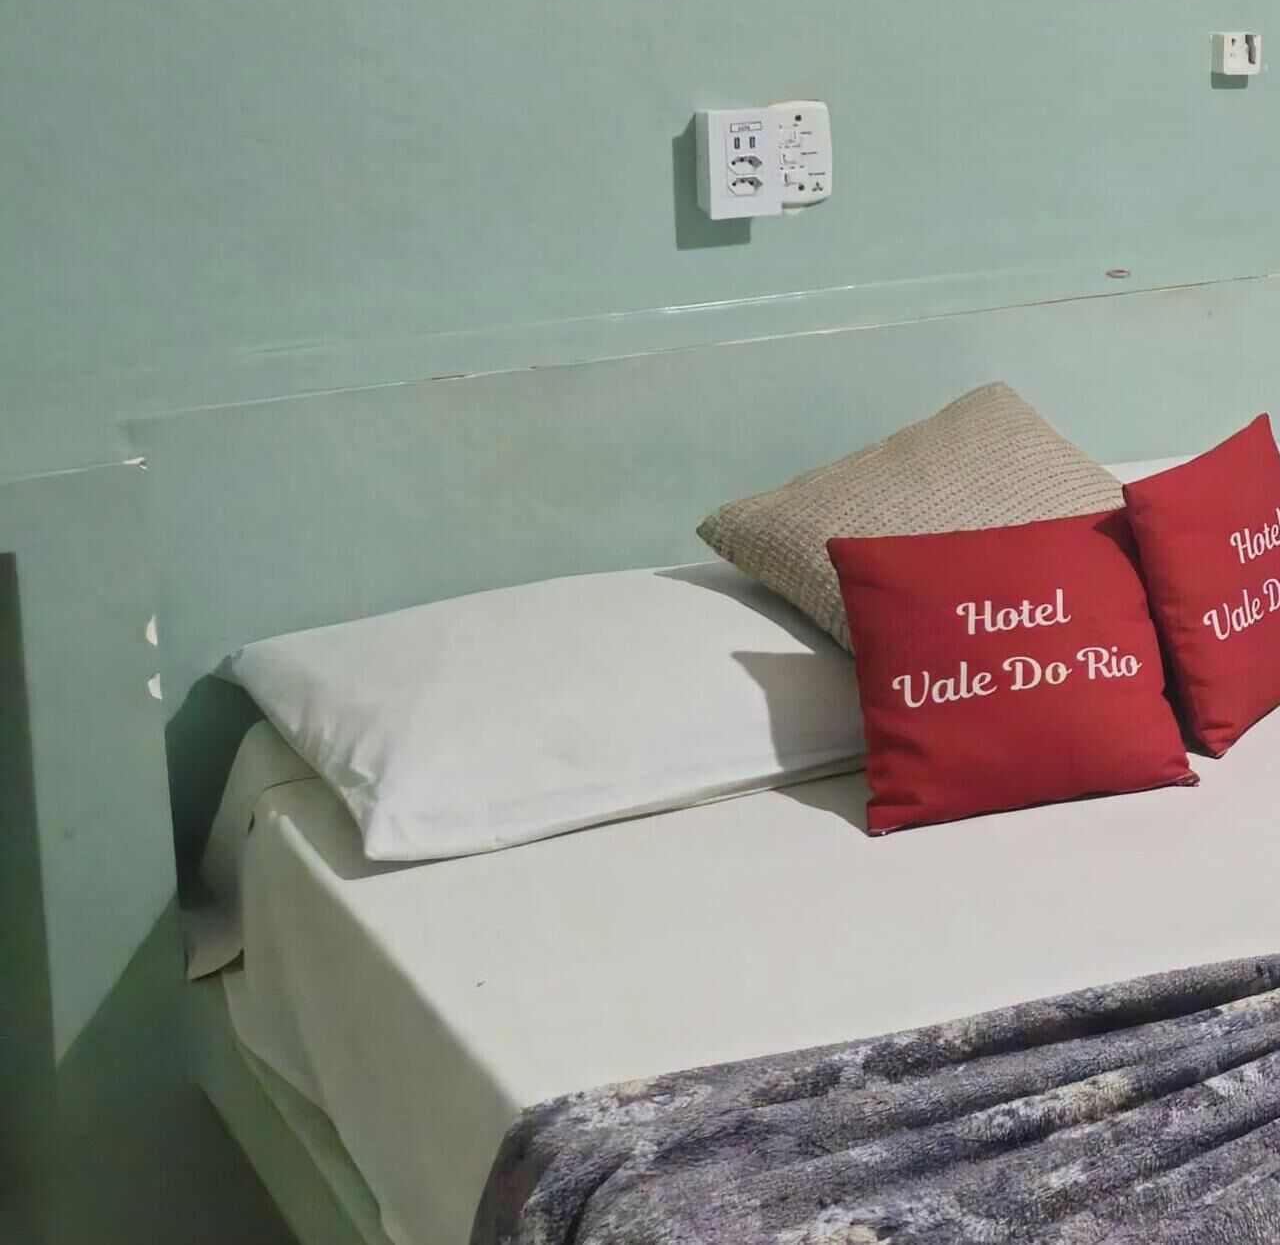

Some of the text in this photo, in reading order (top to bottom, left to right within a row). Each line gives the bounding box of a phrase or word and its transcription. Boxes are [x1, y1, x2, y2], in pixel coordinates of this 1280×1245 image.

[955, 588, 1071, 635] Hotel
[1203, 589, 1264, 640] Vale
[892, 646, 1142, 708] Vale Do Rio
